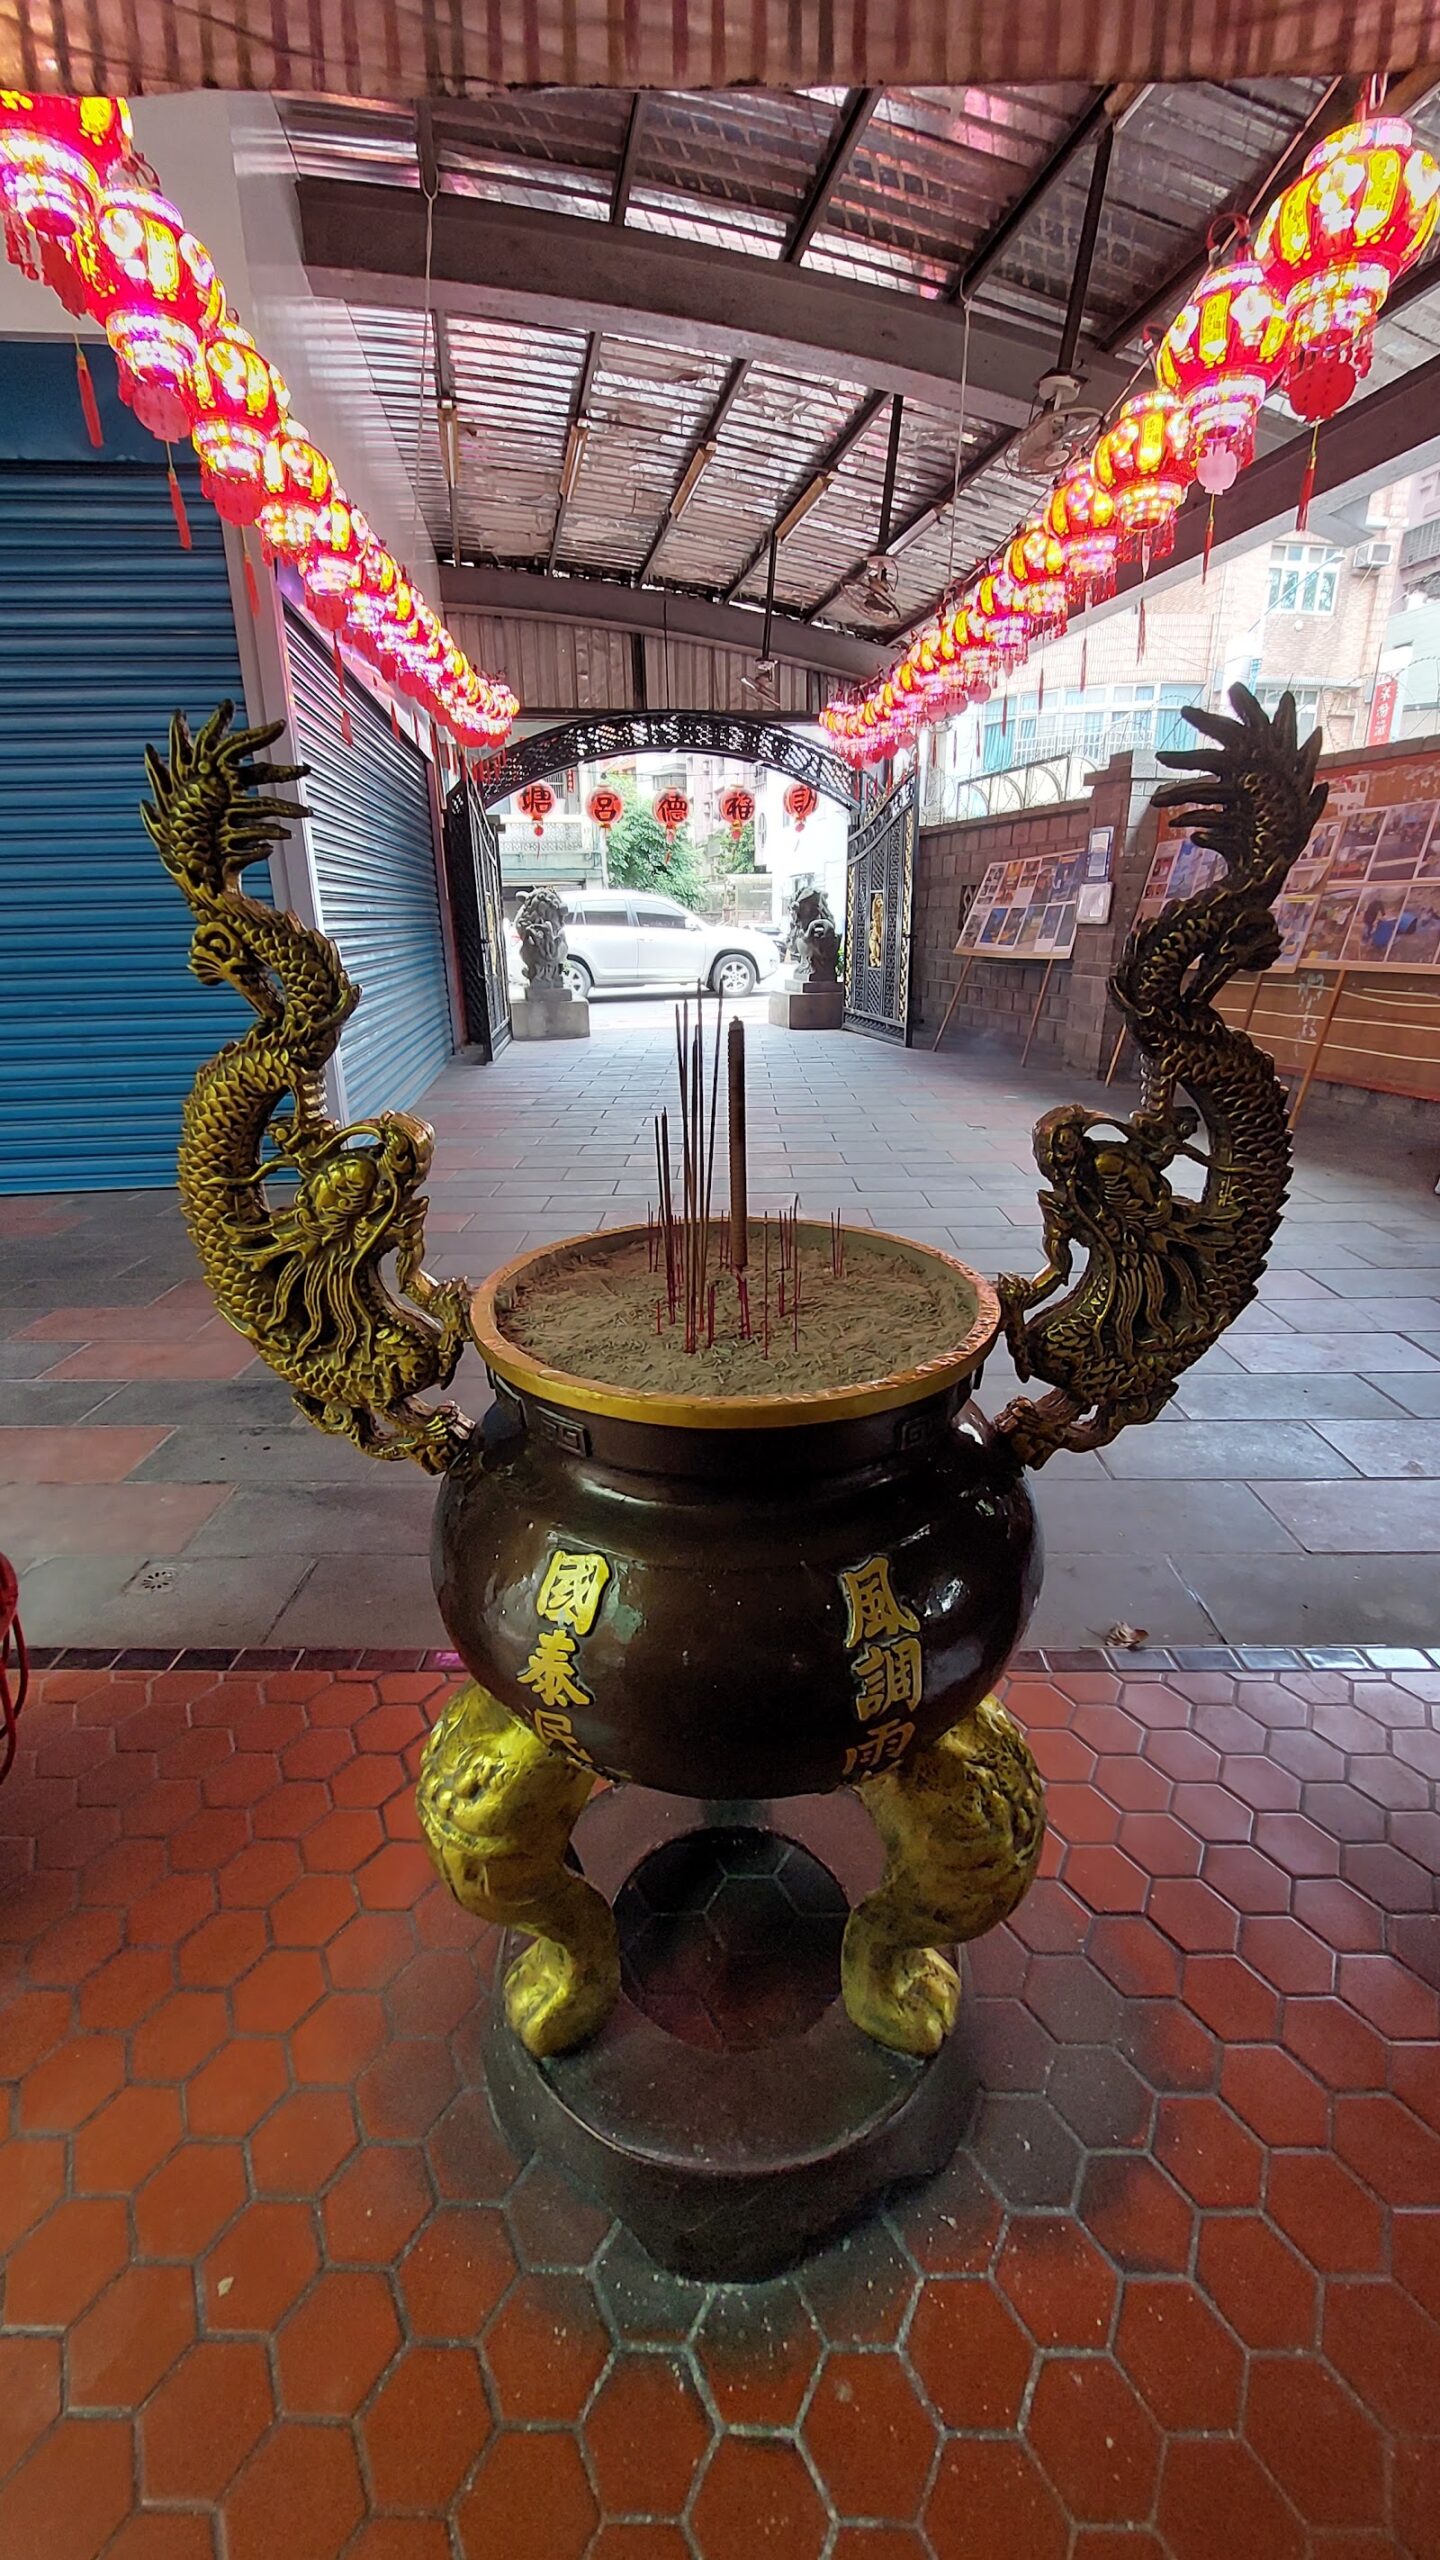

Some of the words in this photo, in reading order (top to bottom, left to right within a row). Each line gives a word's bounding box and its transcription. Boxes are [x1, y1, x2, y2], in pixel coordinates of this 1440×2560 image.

[658, 791, 689, 822] 德
[725, 791, 754, 820] 福
[843, 1556, 922, 1774] 風調雨
